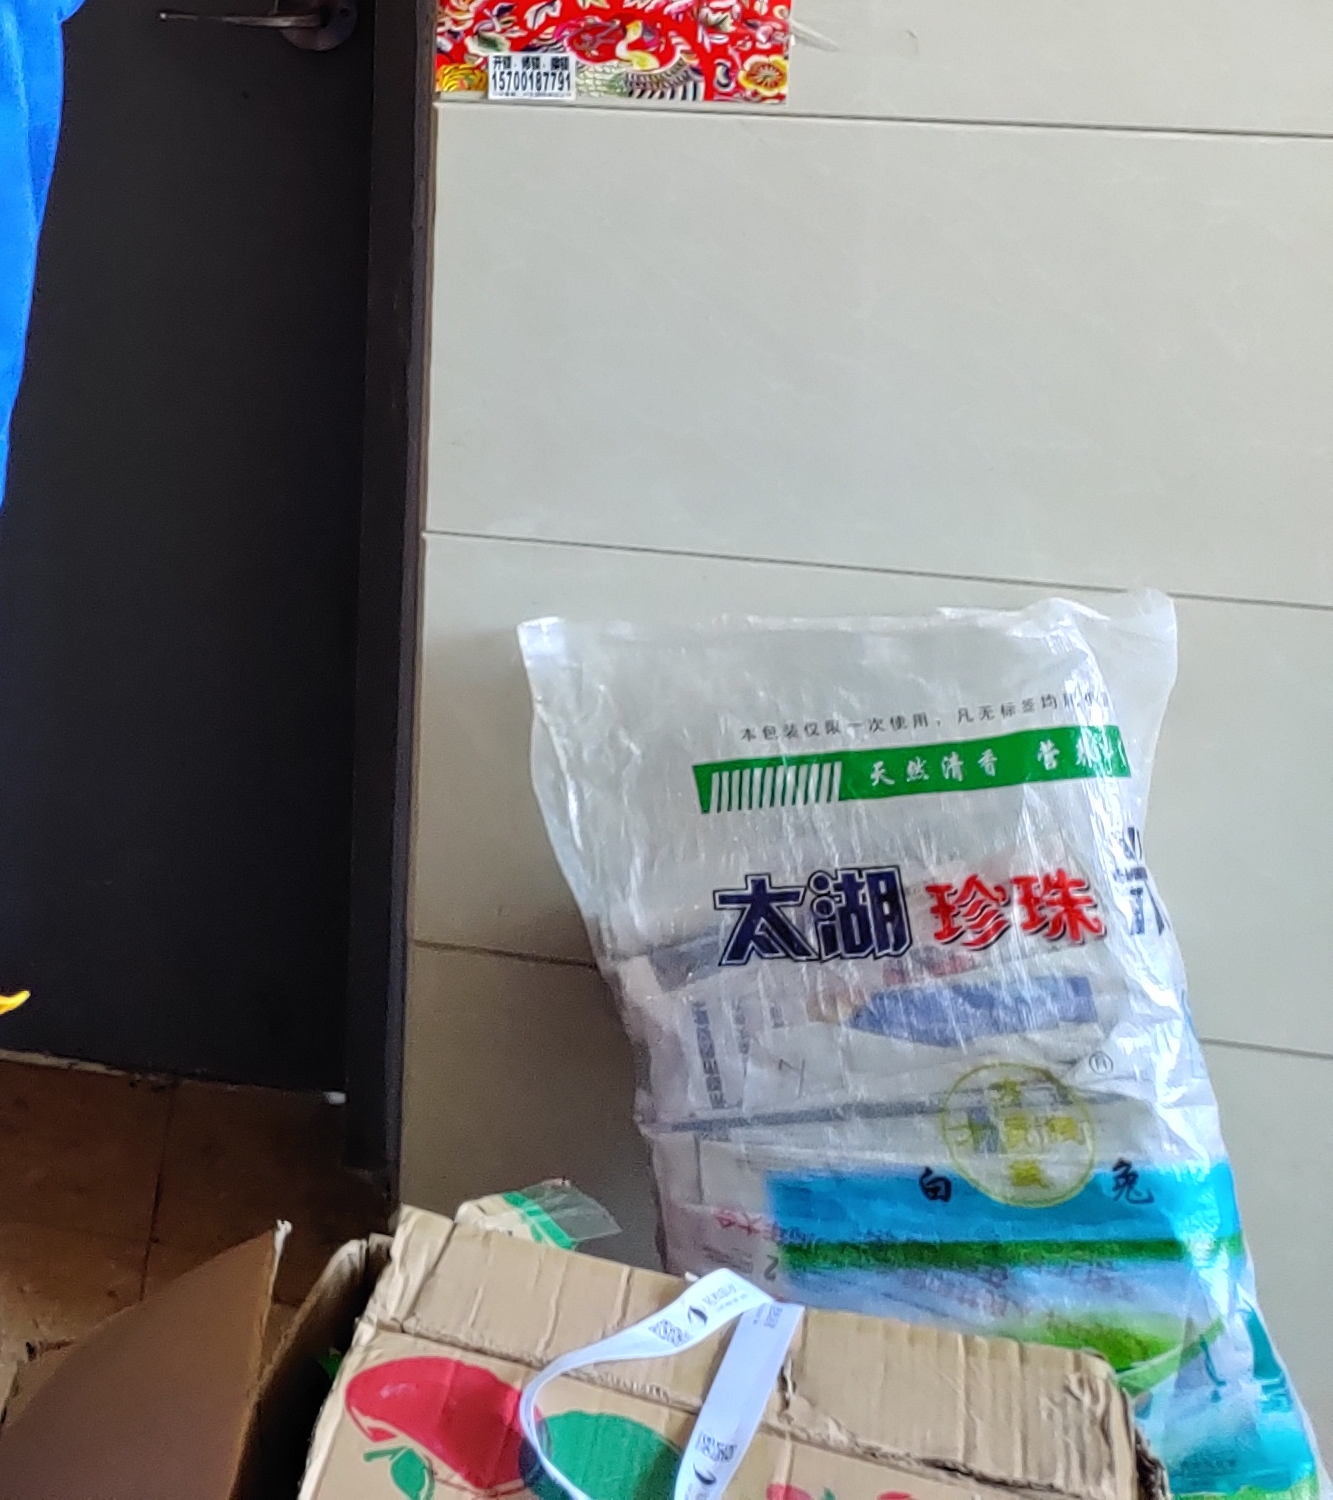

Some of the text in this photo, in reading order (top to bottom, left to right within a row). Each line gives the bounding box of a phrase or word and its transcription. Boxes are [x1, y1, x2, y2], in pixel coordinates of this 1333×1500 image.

[492, 71, 571, 91] 15700187791
[713, 865, 1108, 967] 太湖珍珠
